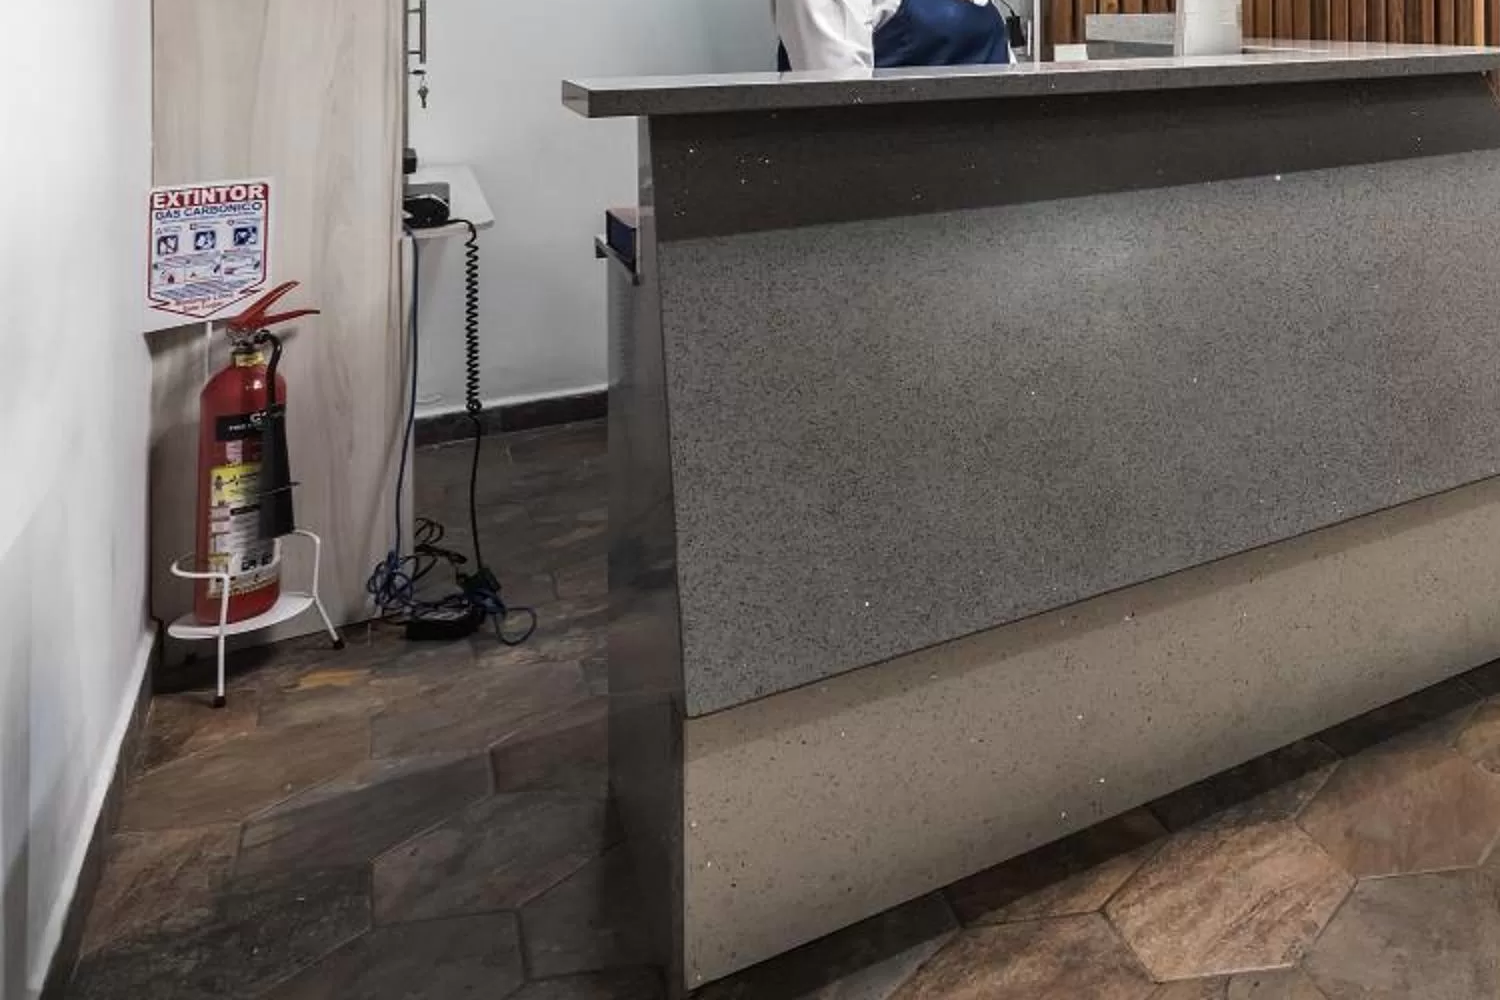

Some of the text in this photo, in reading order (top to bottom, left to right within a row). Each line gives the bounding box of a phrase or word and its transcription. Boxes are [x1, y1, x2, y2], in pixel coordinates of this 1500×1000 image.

[153, 184, 265, 209] EXTINTOR
[155, 210, 181, 221] GAS
[184, 201, 263, 217] CARBONICO
